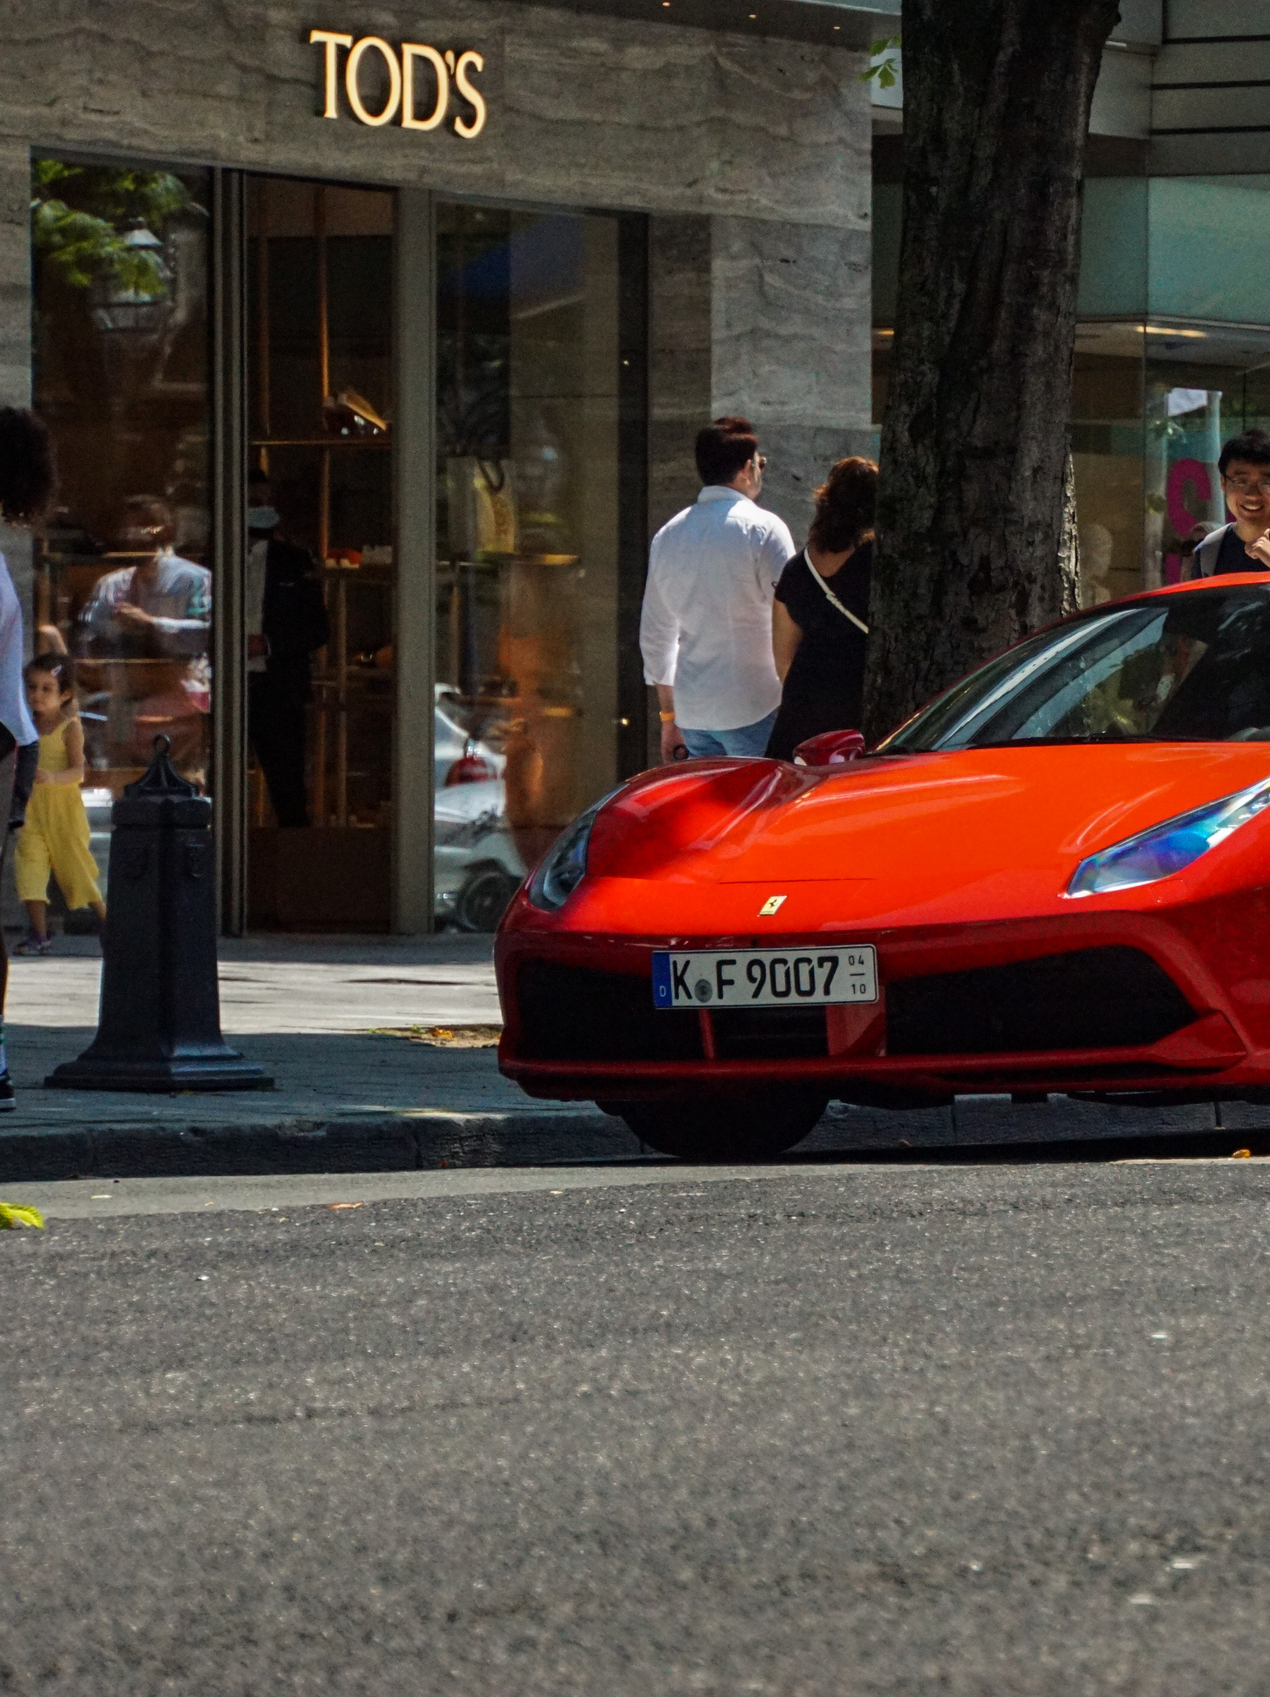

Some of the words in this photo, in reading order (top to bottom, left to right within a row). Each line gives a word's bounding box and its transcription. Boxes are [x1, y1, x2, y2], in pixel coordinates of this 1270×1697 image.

[310, 30, 486, 139] TOD'S
[746, 955, 839, 999] 9007
[848, 954, 865, 967] 04
